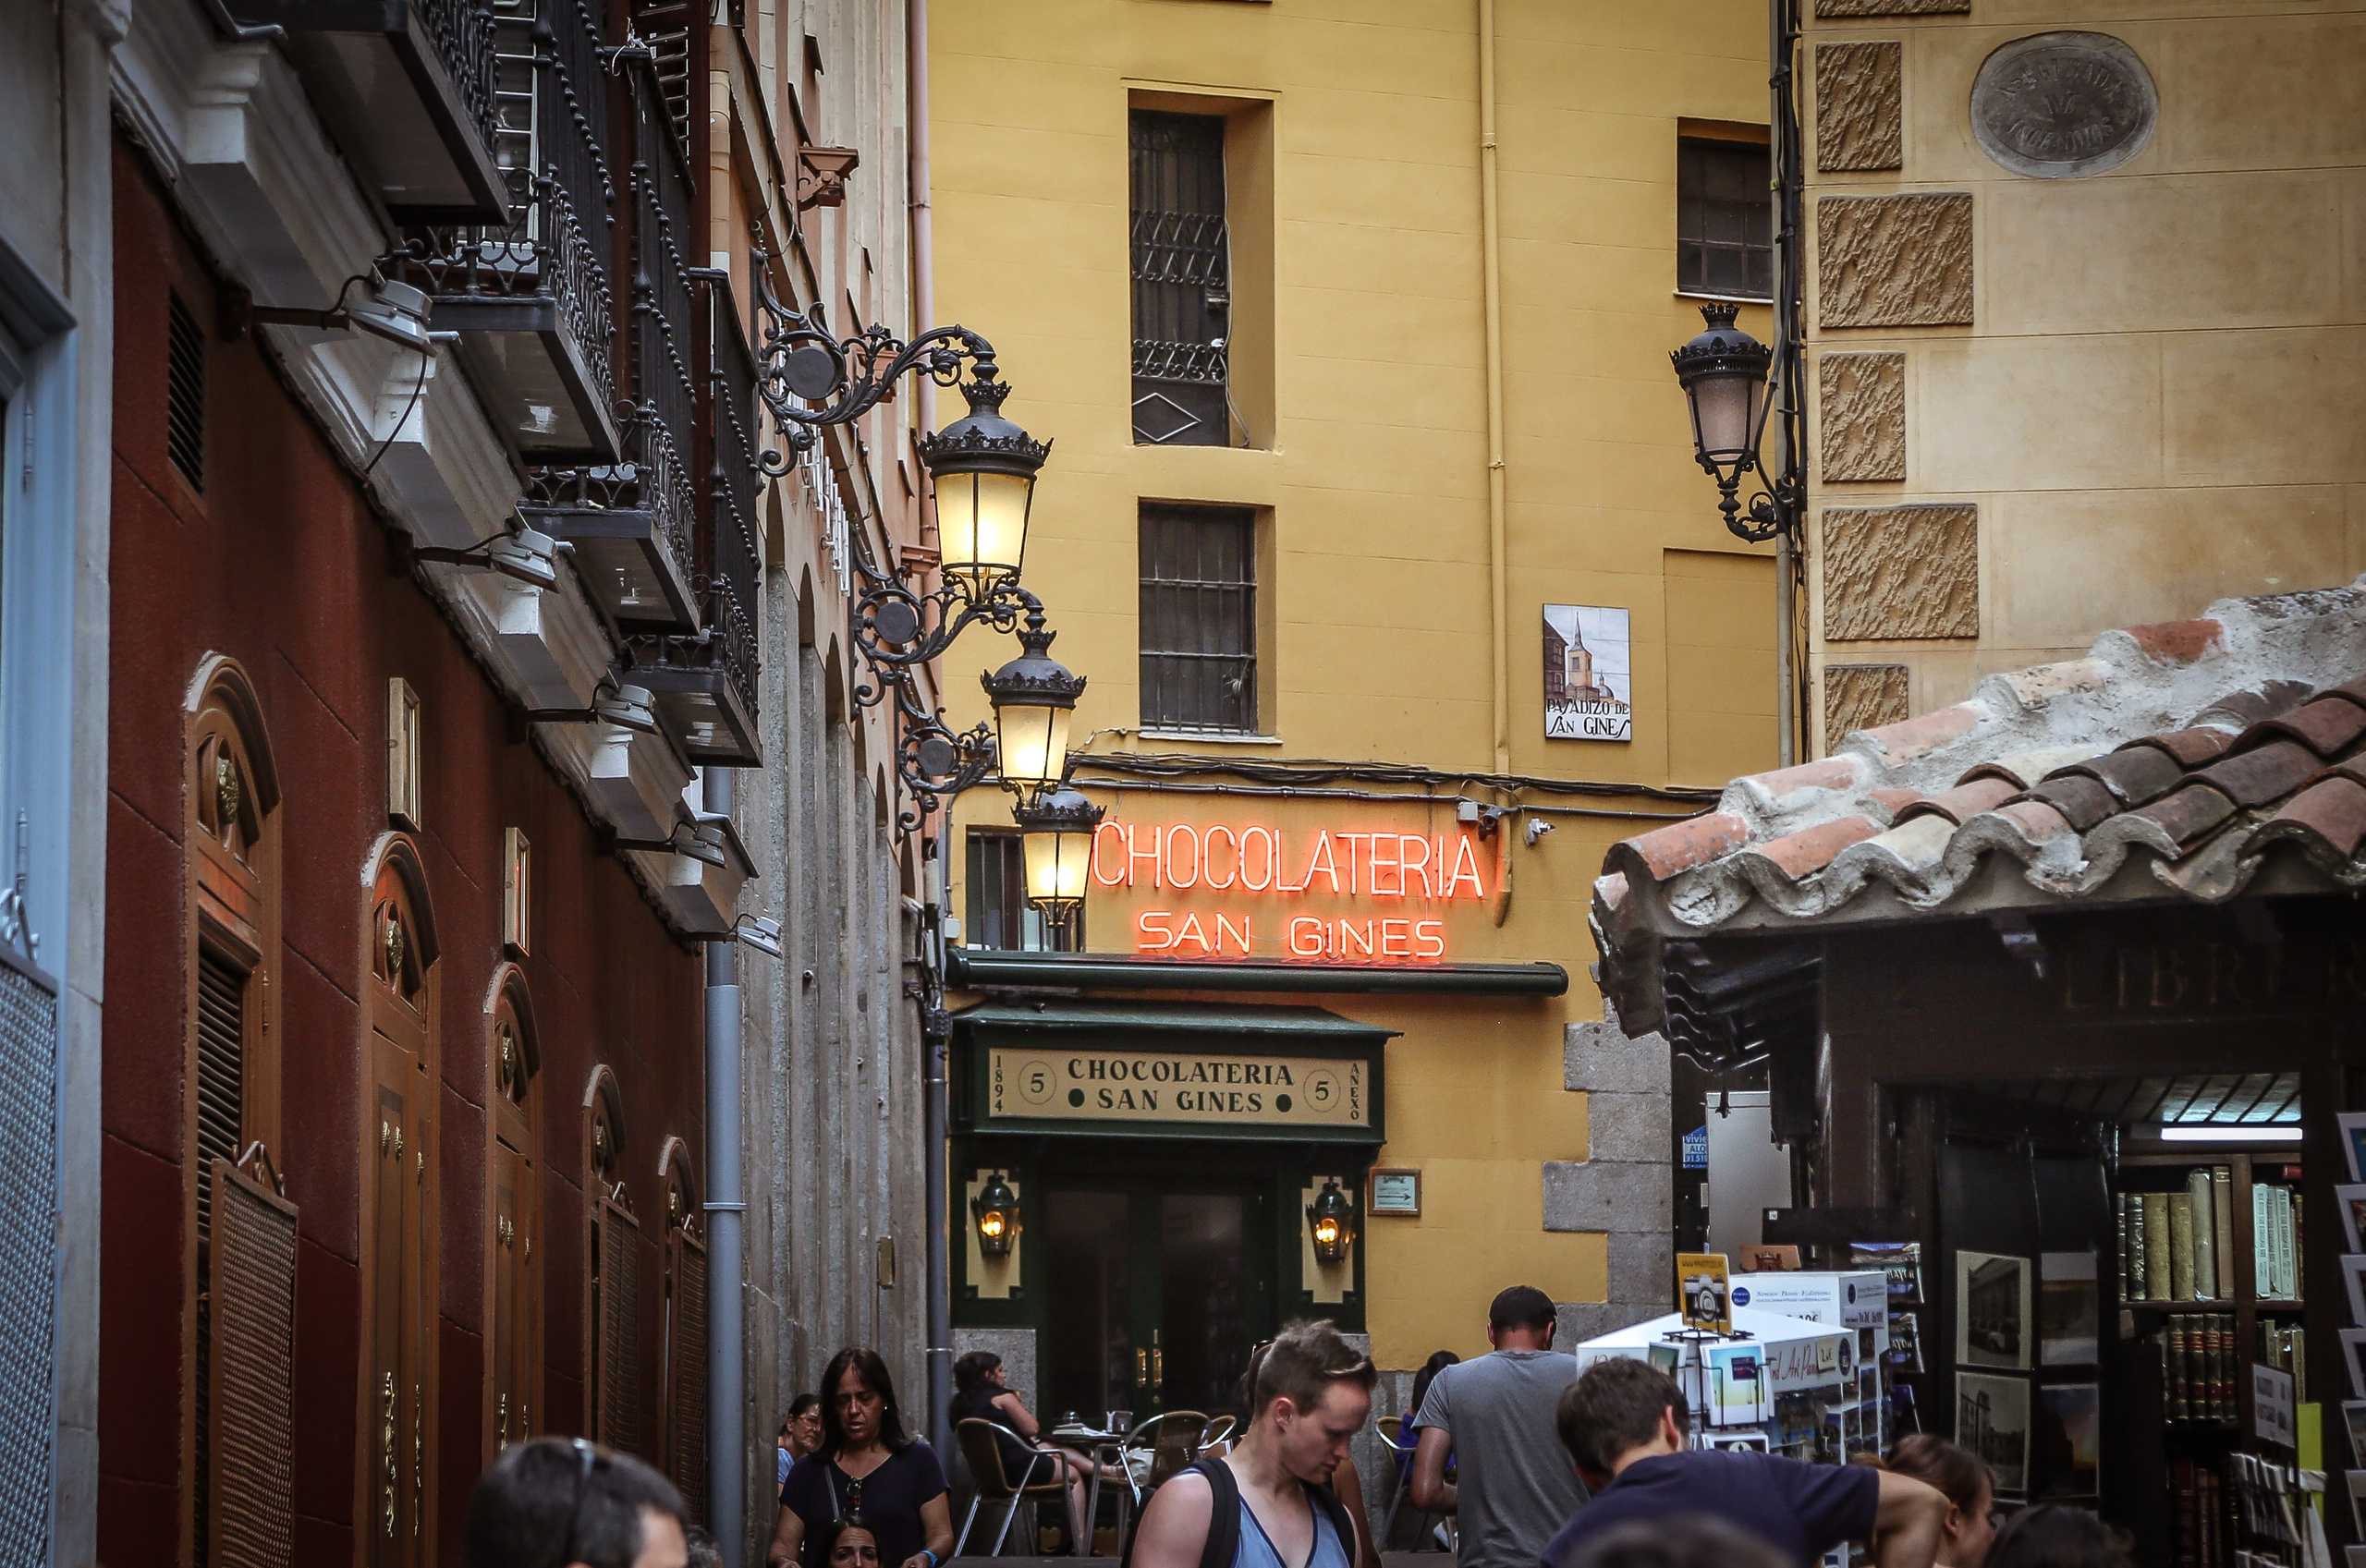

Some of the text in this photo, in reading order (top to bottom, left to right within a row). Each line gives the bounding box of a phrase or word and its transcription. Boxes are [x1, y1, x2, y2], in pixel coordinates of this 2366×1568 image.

[1546, 699, 1629, 716] PASADIZO DE
[1548, 715, 1631, 738] SAN GINES
[1093, 820, 1484, 899] CHOCOLATERIA
[1138, 911, 1445, 957] SAN GINES
[1030, 1072, 1045, 1094] 5
[1067, 1058, 1294, 1086] CHOCOLATERIA
[1097, 1088, 1262, 1113] SAN GINES
[1314, 1080, 1330, 1101] 5
[1349, 1063, 1360, 1120] ANEXO
[1889, 1339, 1913, 1352] AYOR
